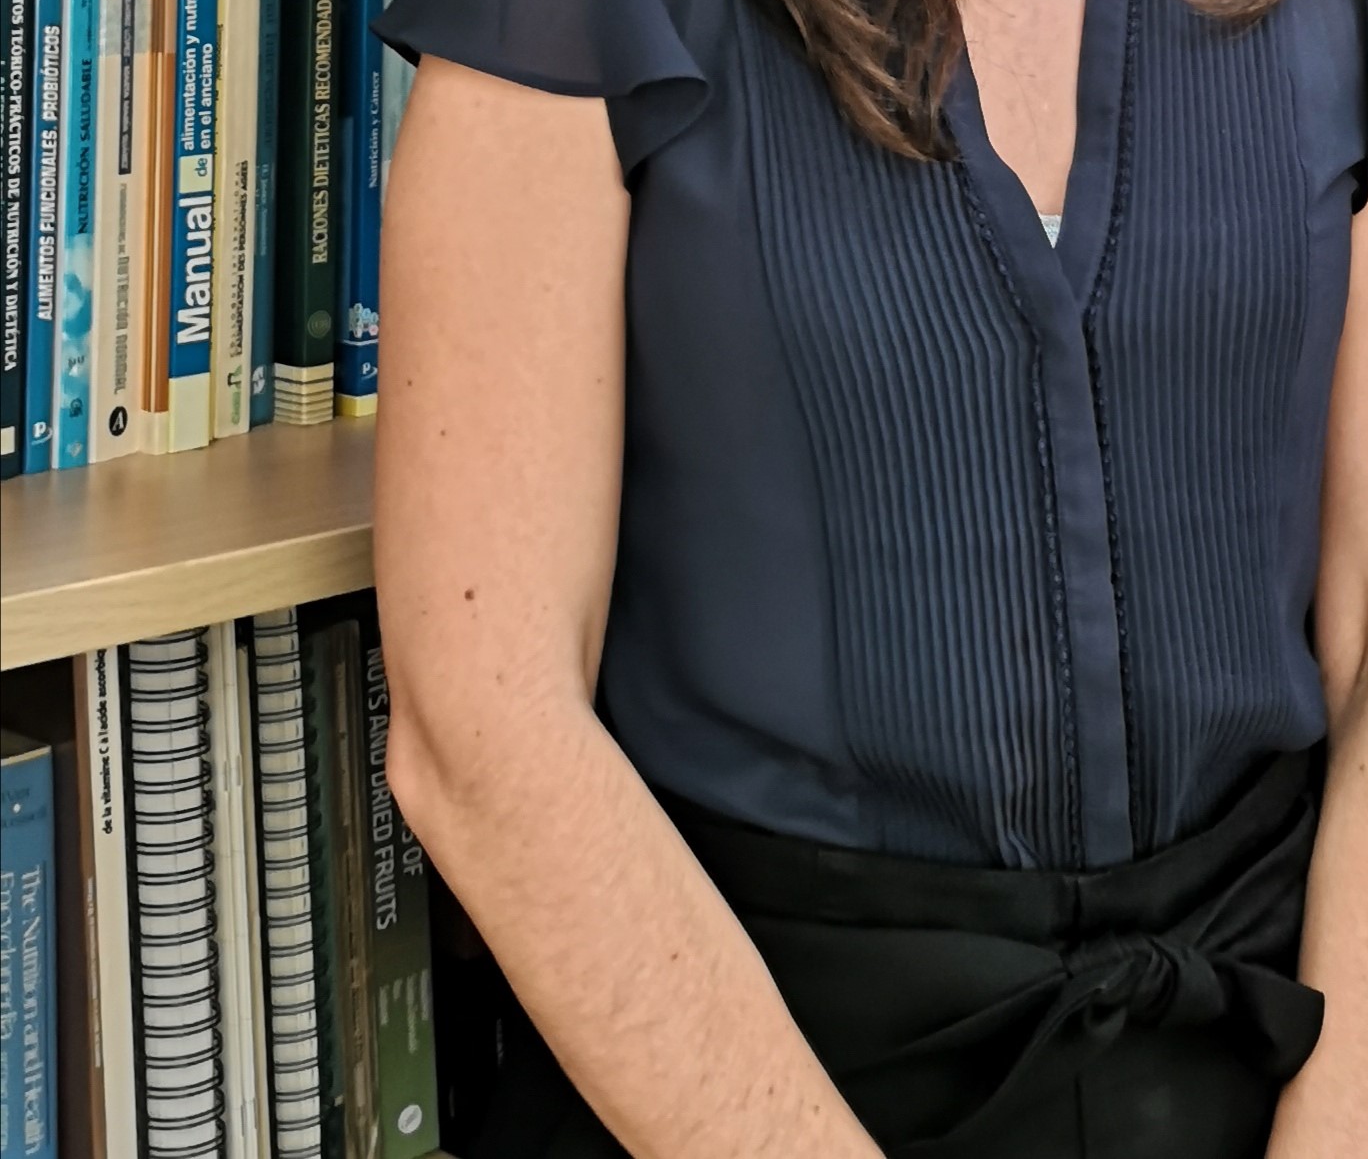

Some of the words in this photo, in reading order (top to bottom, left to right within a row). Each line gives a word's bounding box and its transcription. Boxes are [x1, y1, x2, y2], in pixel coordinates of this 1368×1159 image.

[40, 26, 61, 122] PROBIÓTICOS
[186, 35, 200, 45] y
[200, 43, 213, 107] anciano
[9, 29, 24, 173] TEÓRICO-PRÁCTICOS
[79, 58, 92, 141] SALUDABLE
[182, 48, 197, 150] alimentación
[199, 110, 211, 123] el
[368, 71, 380, 115] Cáncer
[195, 158, 208, 177] de
[202, 127, 212, 149] en
[313, 104, 331, 187] DIETETICAS
[368, 128, 379, 188] Nutrición
[7, 179, 19, 197] DE
[38, 126, 58, 232] FUNCIONALES.
[77, 146, 90, 234] NUTRICIÓN
[6, 202, 19, 277] NUTRICIÓN
[312, 190, 329, 263] RACIONES
[7, 281, 18, 290] Y
[37, 236, 55, 321] ALIMENTOS
[176, 196, 212, 344] Manual
[4, 294, 18, 371] DIETÉTICA
[20, 865, 41, 913] The
[401, 847, 424, 876] OF
[22, 916, 41, 1021] Nutrition
[23, 1024, 43, 1072] and
[23, 1074, 44, 1155] Health
